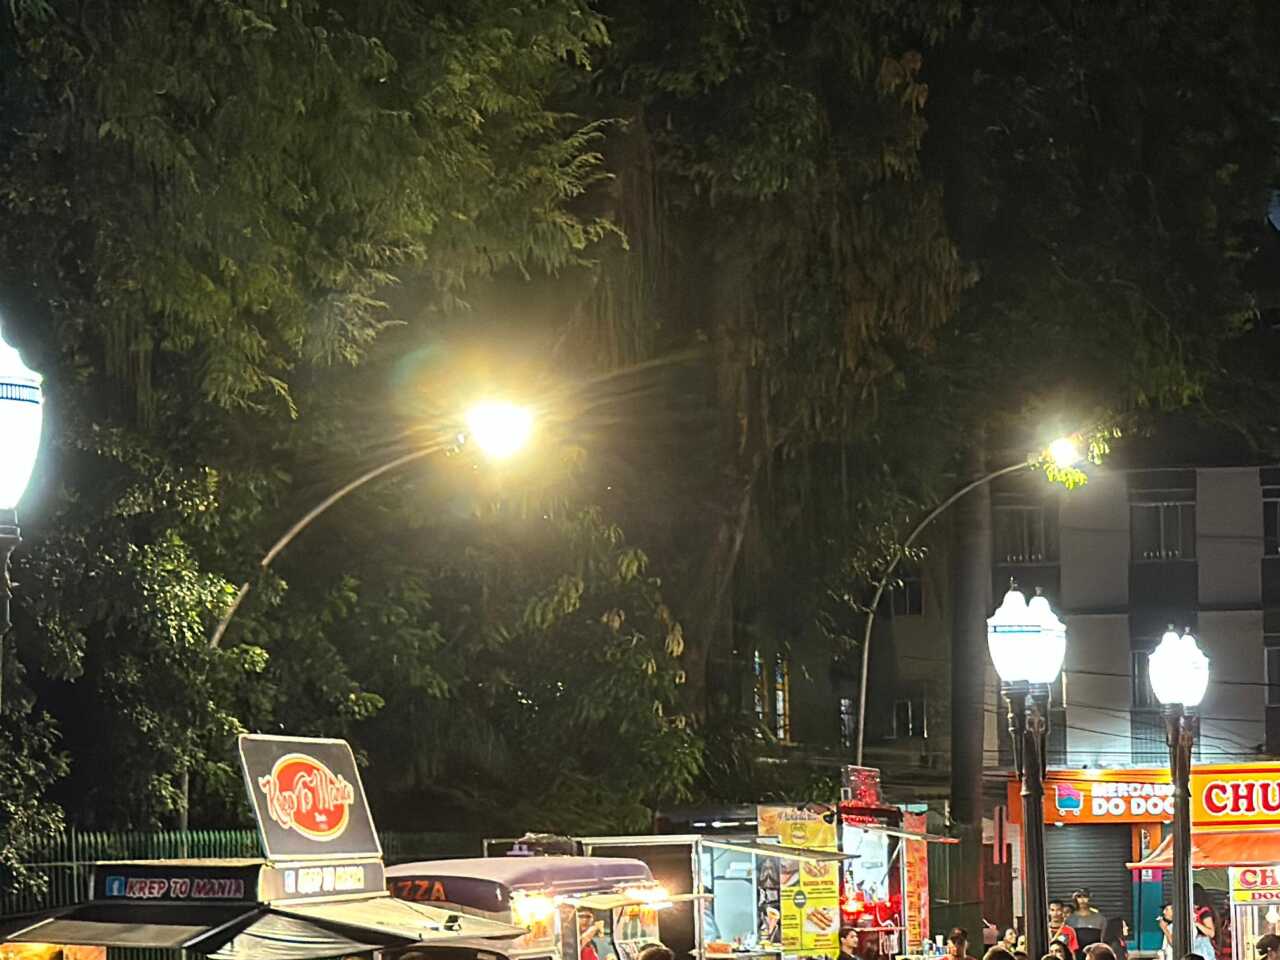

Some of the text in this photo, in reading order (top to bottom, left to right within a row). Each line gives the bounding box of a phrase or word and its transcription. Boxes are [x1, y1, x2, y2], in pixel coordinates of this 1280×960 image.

[1092, 797, 1126, 815] DO
[126, 877, 168, 898] KREP
[170, 878, 191, 898] TO
[192, 878, 245, 899] MANIA
